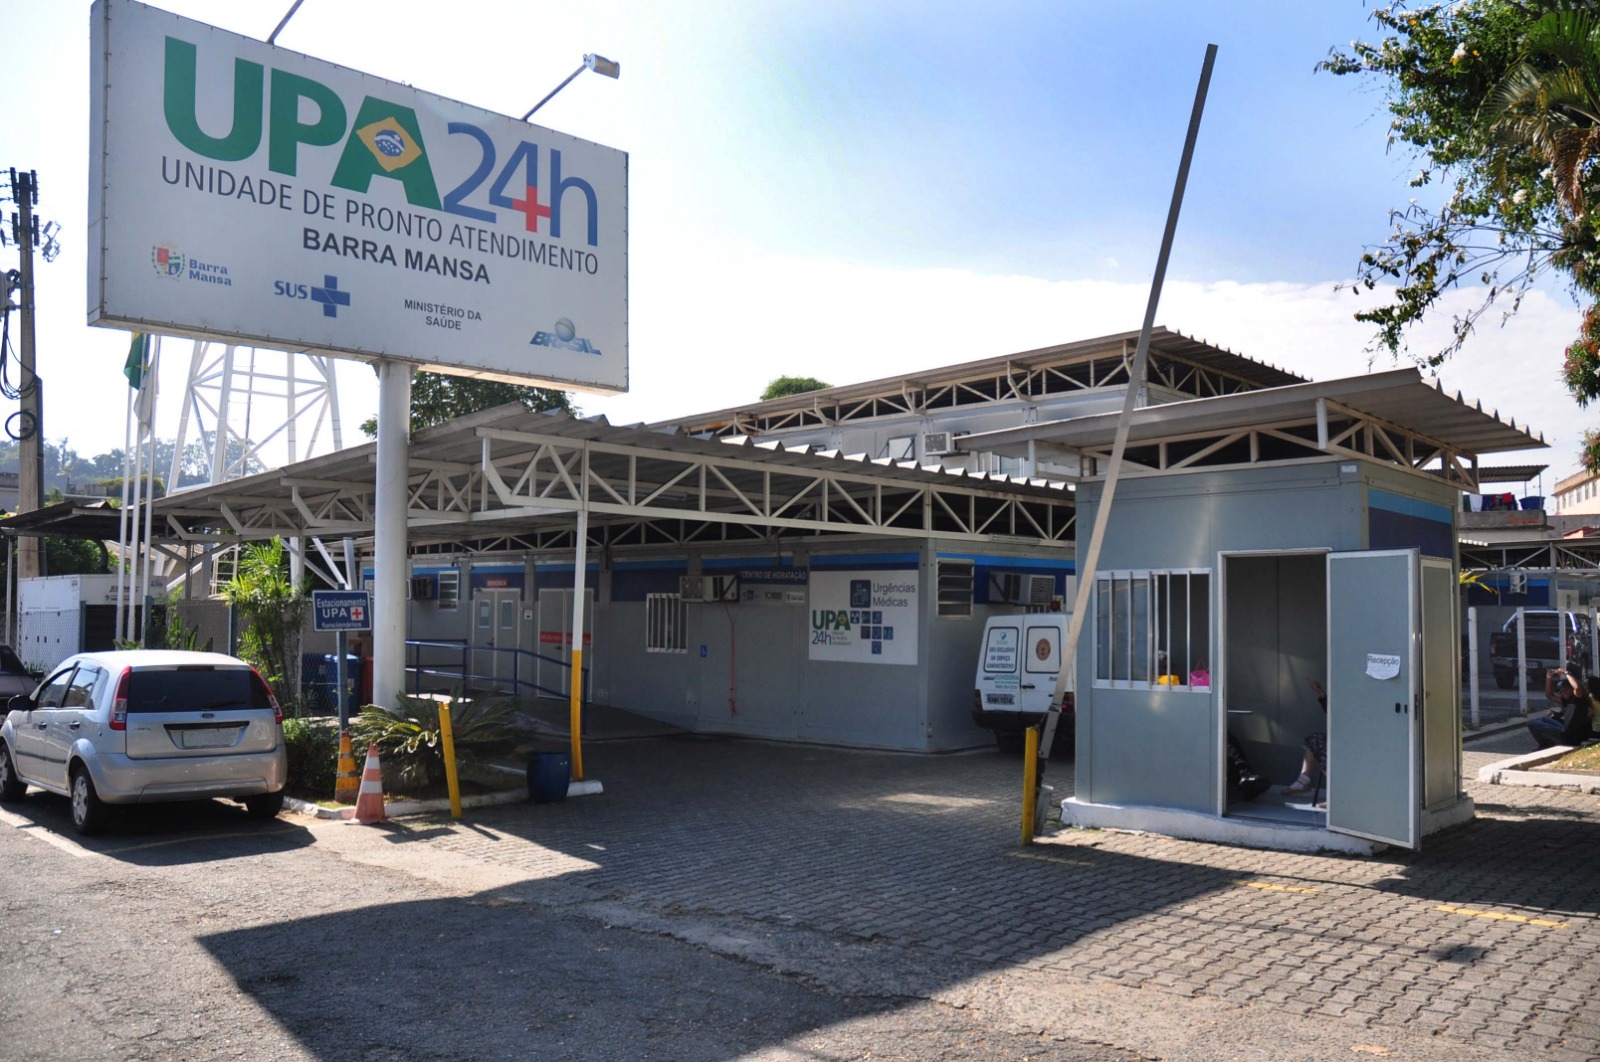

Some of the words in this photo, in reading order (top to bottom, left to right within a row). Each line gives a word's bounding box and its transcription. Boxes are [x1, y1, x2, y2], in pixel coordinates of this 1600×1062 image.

[163, 35, 444, 211] UPA
[443, 122, 598, 247] 24h
[162, 155, 293, 211] UNIDADE
[303, 189, 336, 220] DE
[346, 199, 443, 242] PRONTO
[449, 223, 599, 276] ATENDIMENTO
[302, 227, 397, 267] BARRA
[404, 250, 491, 285] MANSA
[189, 259, 228, 275] Barra
[189, 270, 232, 287] Mansa
[274, 280, 308, 300] SUS
[404, 299, 465, 318] MINISTÉRIO
[467, 310, 482, 321] DA
[425, 315, 462, 330] SAÚDE
[741, 571, 763, 579] CENTRO
[763, 571, 771, 579] DE
[772, 570, 807, 581] HIDRATAÇÃO
[873, 583, 916, 595] Urgências
[317, 598, 367, 608] Estacionamento
[873, 597, 908, 607] Médicas
[322, 607, 347, 619] UPA
[812, 610, 851, 630] UPA
[321, 621, 362, 629] funcionários
[812, 630, 832, 646] 24h
[1367, 656, 1400, 667] Recepção
